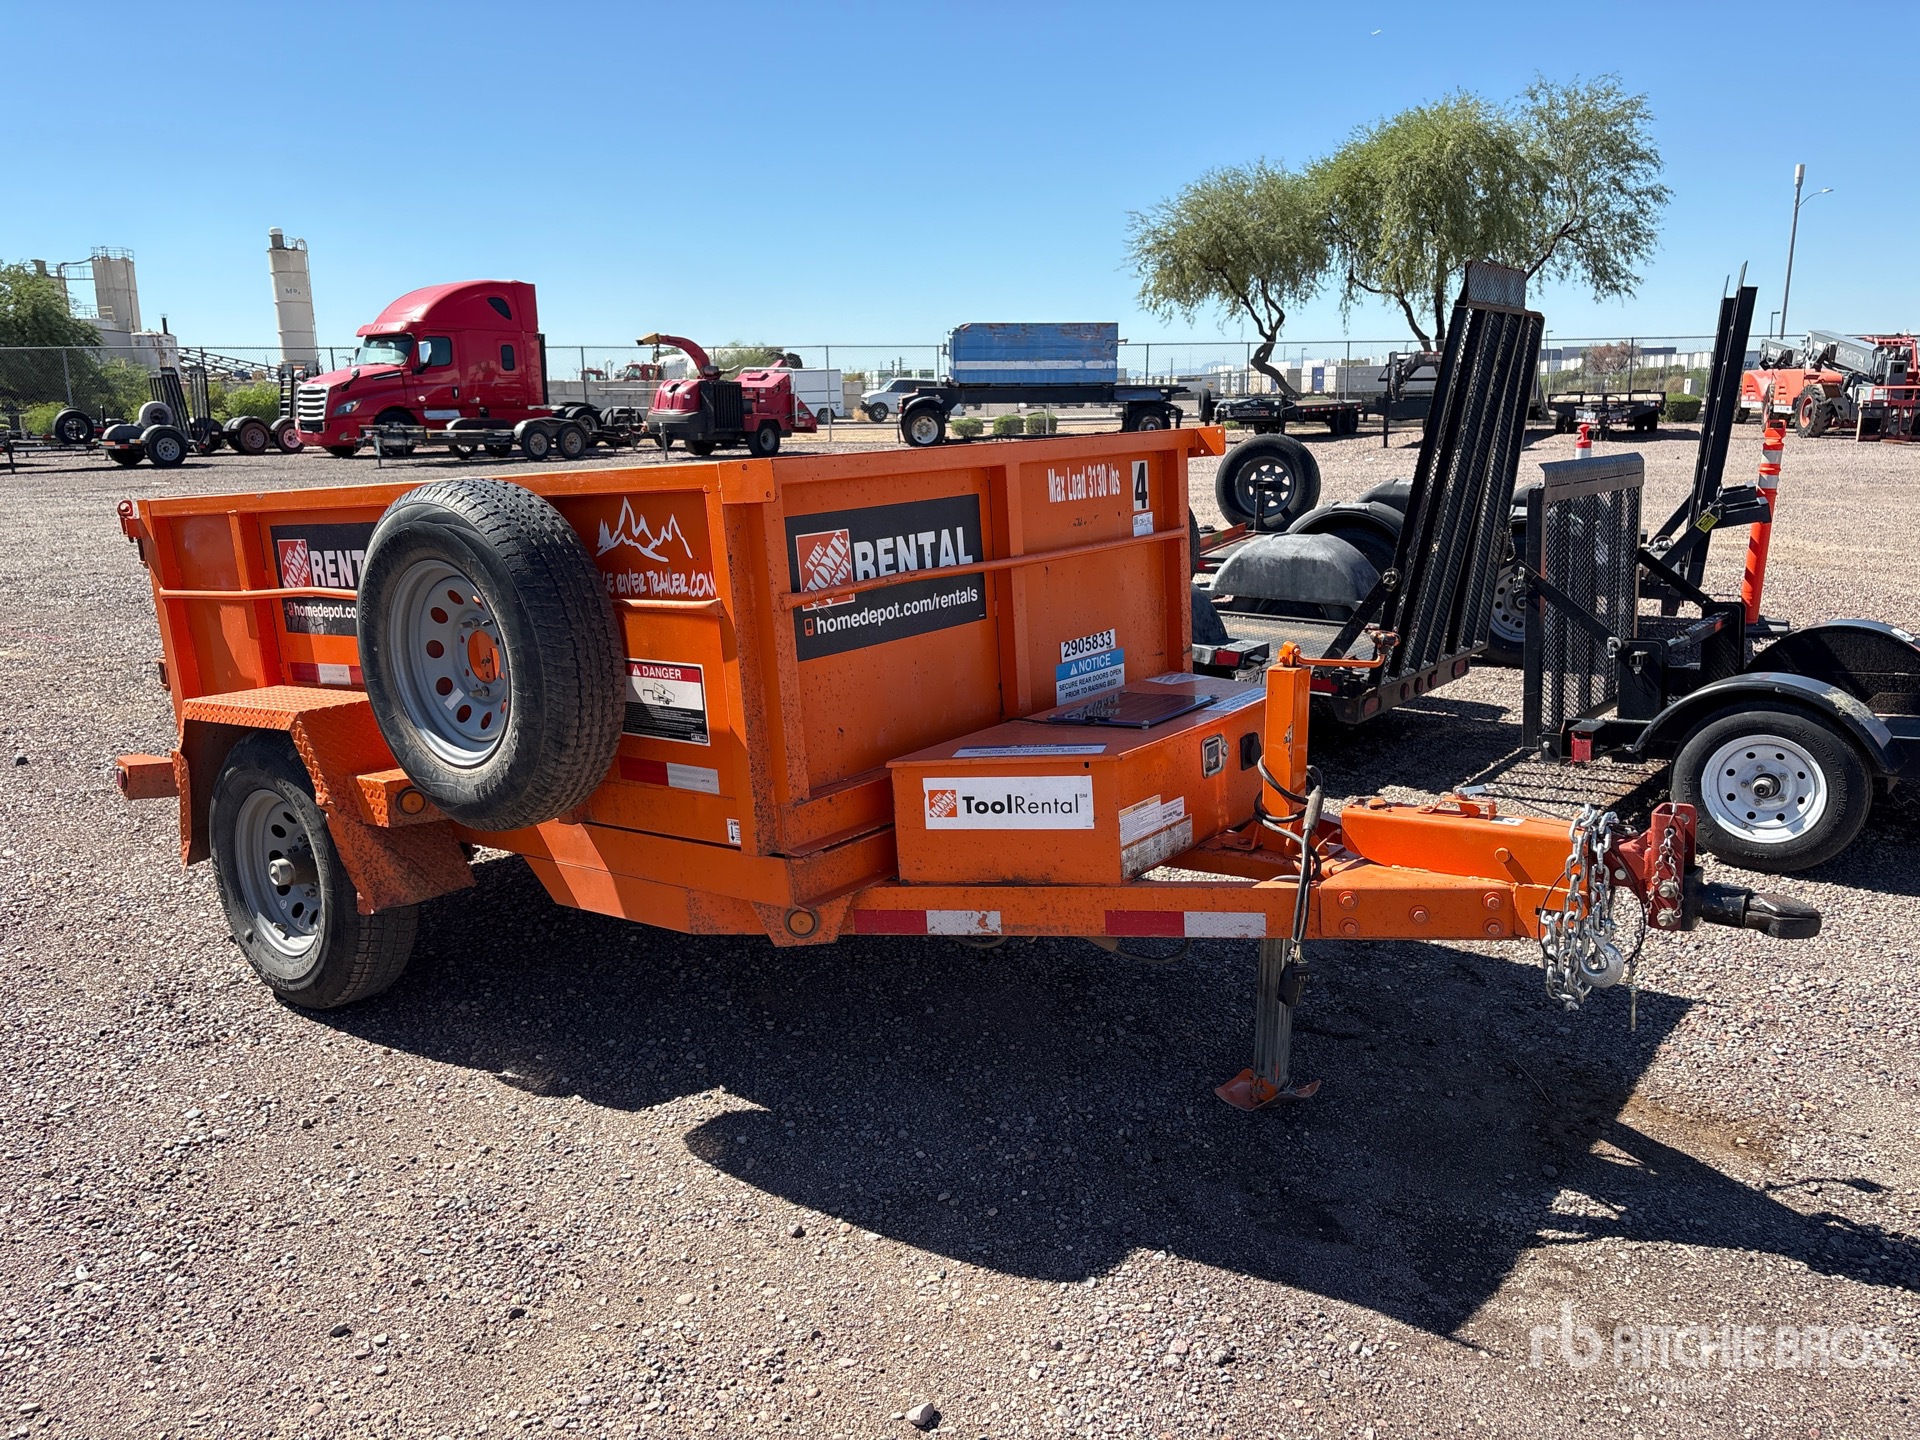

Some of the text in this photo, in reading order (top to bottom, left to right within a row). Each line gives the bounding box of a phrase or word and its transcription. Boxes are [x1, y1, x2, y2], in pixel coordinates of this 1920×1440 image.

[1047, 468, 1066, 503] Max
[1067, 465, 1086, 501] Load
[1088, 463, 1107, 499] 3130
[1135, 462, 1148, 509] 4
[804, 541, 826, 572] THE
[853, 526, 974, 582] RENTAL
[816, 586, 978, 635] homedepot.com/rentals
[1063, 630, 1112, 658] 2905833
[642, 665, 682, 680] DANGER
[1078, 653, 1111, 673] NOTICE
[1059, 667, 1122, 692] SECURE REAR DOORS OPEN
[1065, 678, 1117, 699] PRIOR TO RAISING BED
[929, 790, 957, 818] HOME
[931, 791, 943, 805] THE
[940, 799, 957, 818] DEPOT
[961, 793, 1079, 815] ToolRental
